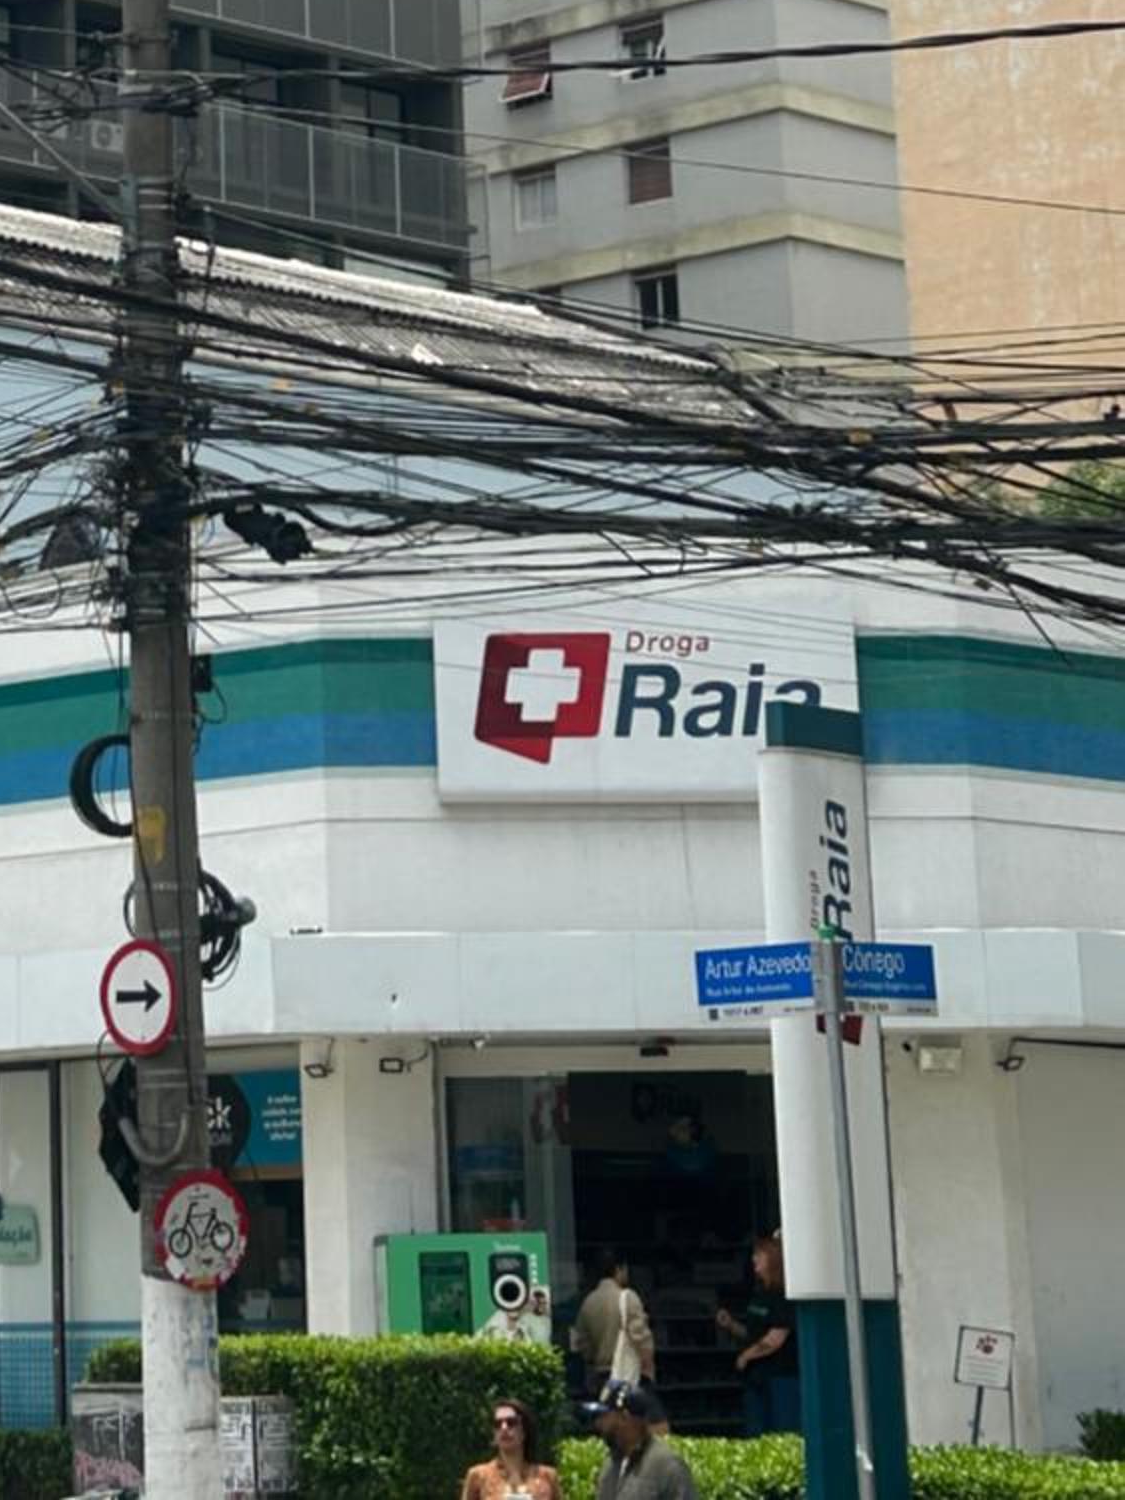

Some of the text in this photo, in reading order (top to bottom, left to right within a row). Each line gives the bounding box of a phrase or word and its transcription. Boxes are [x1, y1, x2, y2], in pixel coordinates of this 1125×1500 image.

[626, 631, 710, 657] Droga
[819, 799, 854, 942] Raia
[705, 952, 812, 980] Artur Azevedo
